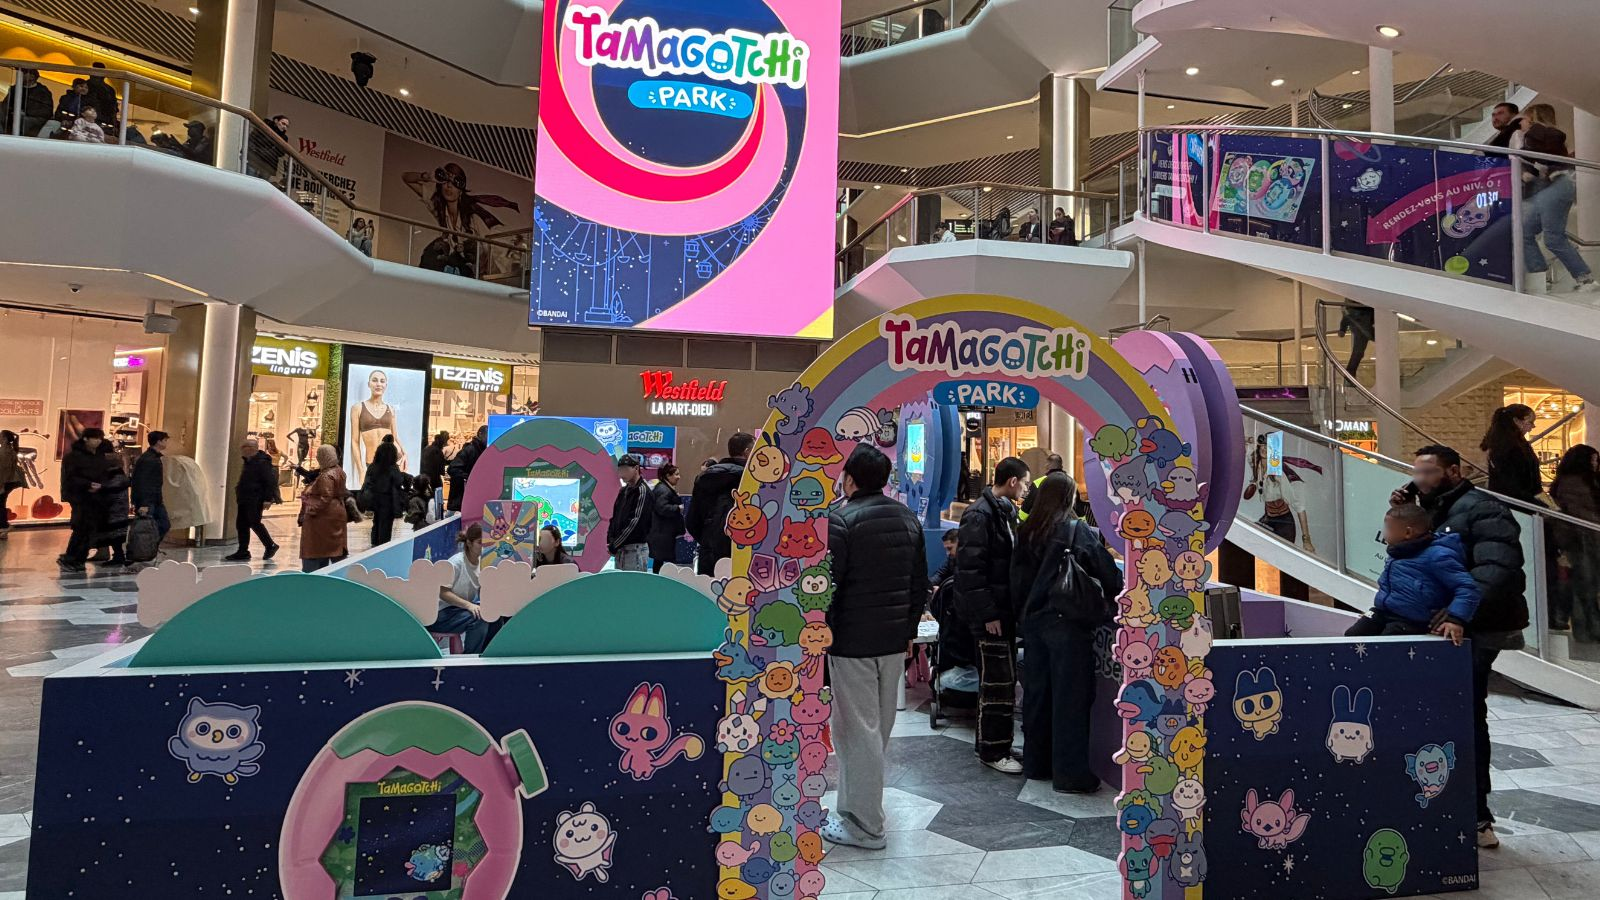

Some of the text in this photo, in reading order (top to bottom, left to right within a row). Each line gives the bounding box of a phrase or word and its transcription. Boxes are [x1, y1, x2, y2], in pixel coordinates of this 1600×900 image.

[658, 86, 728, 111] PARK
[299, 137, 347, 166] Westfield
[1382, 192, 1445, 230] RENDEZ-VOUS
[1446, 186, 1461, 197] AU
[1463, 181, 1484, 192] NIV.
[270, 365, 313, 375] lingerie
[461, 381, 500, 392] lingerie
[639, 370, 728, 402] Westfield
[957, 382, 1018, 405] PARK
[651, 402, 713, 416] LA PART-DIEU
